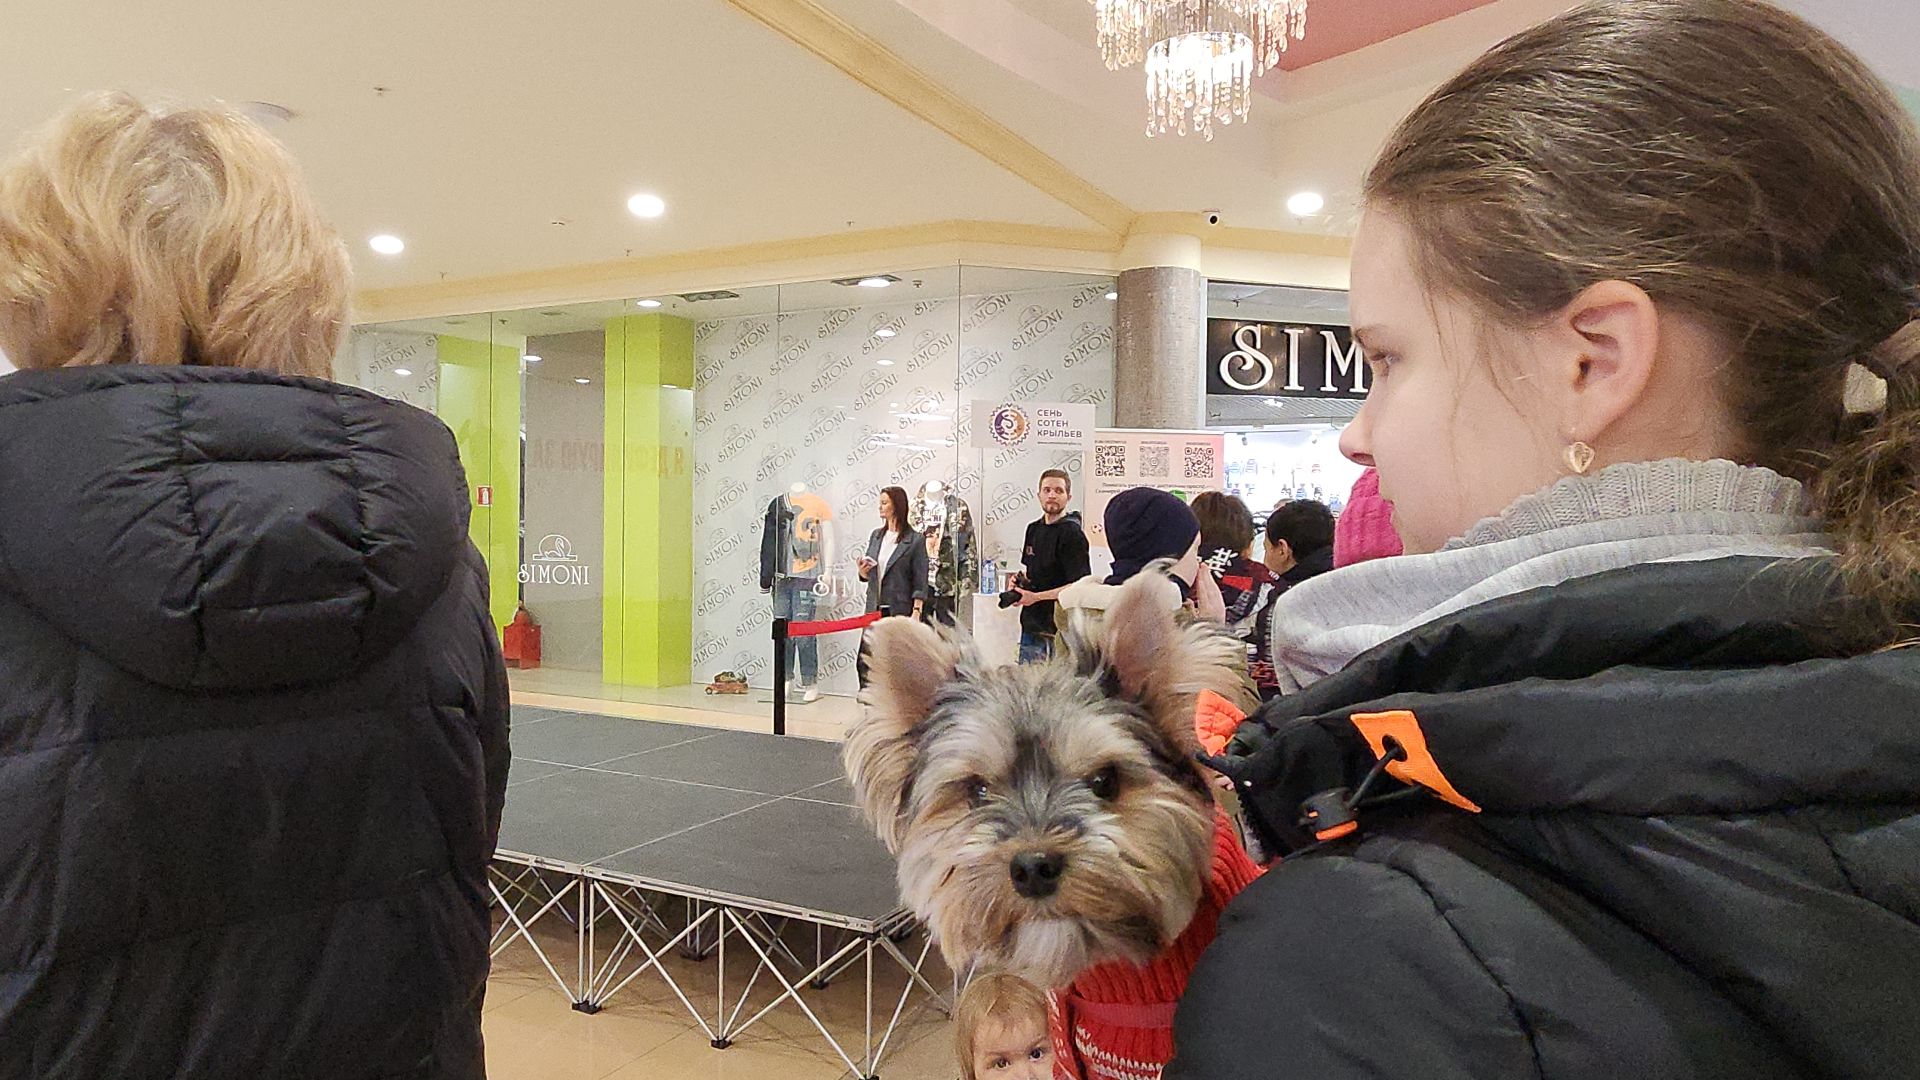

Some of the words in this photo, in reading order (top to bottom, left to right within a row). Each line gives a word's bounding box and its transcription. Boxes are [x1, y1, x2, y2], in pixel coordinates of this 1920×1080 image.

[962, 294, 1011, 333] SIMONI
[1073, 285, 1110, 309] SIM
[729, 322, 770, 360] SIMONI
[1012, 308, 1063, 351] SIMONI
[368, 345, 417, 374] SIMONI
[769, 338, 810, 376] SIMONI
[906, 333, 953, 373] SIMONI
[1063, 326, 1114, 369] SIMONI
[1219, 324, 1369, 393] SIM
[811, 355, 853, 394] SIMONI
[953, 351, 1002, 392] SIMONI
[1005, 368, 1053, 402] IMONI
[723, 376, 763, 412] SIMONI
[854, 373, 898, 411] SIMONI
[762, 393, 803, 430] SIMONI
[803, 410, 846, 448] SIMONI
[1037, 409, 1062, 417] СЕНЬ
[1037, 419, 1069, 428] СОТЕН
[717, 428, 756, 463] SIMONI
[1037, 429, 1082, 438] КРЫЛЬЕВ
[756, 447, 796, 482] SIMONI
[890, 449, 937, 485] SIMONI
[710, 481, 748, 515] SIMONI
[839, 485, 881, 520] SIMONI
[985, 487, 1034, 526] SIMONI
[704, 532, 742, 566] SIMONI
[517, 563, 590, 586] SIMONI
[813, 574, 857, 597] SIM
[697, 584, 736, 617] SIMONI
[823, 593, 867, 622] IMONI
[735, 604, 774, 638] SIMONI
